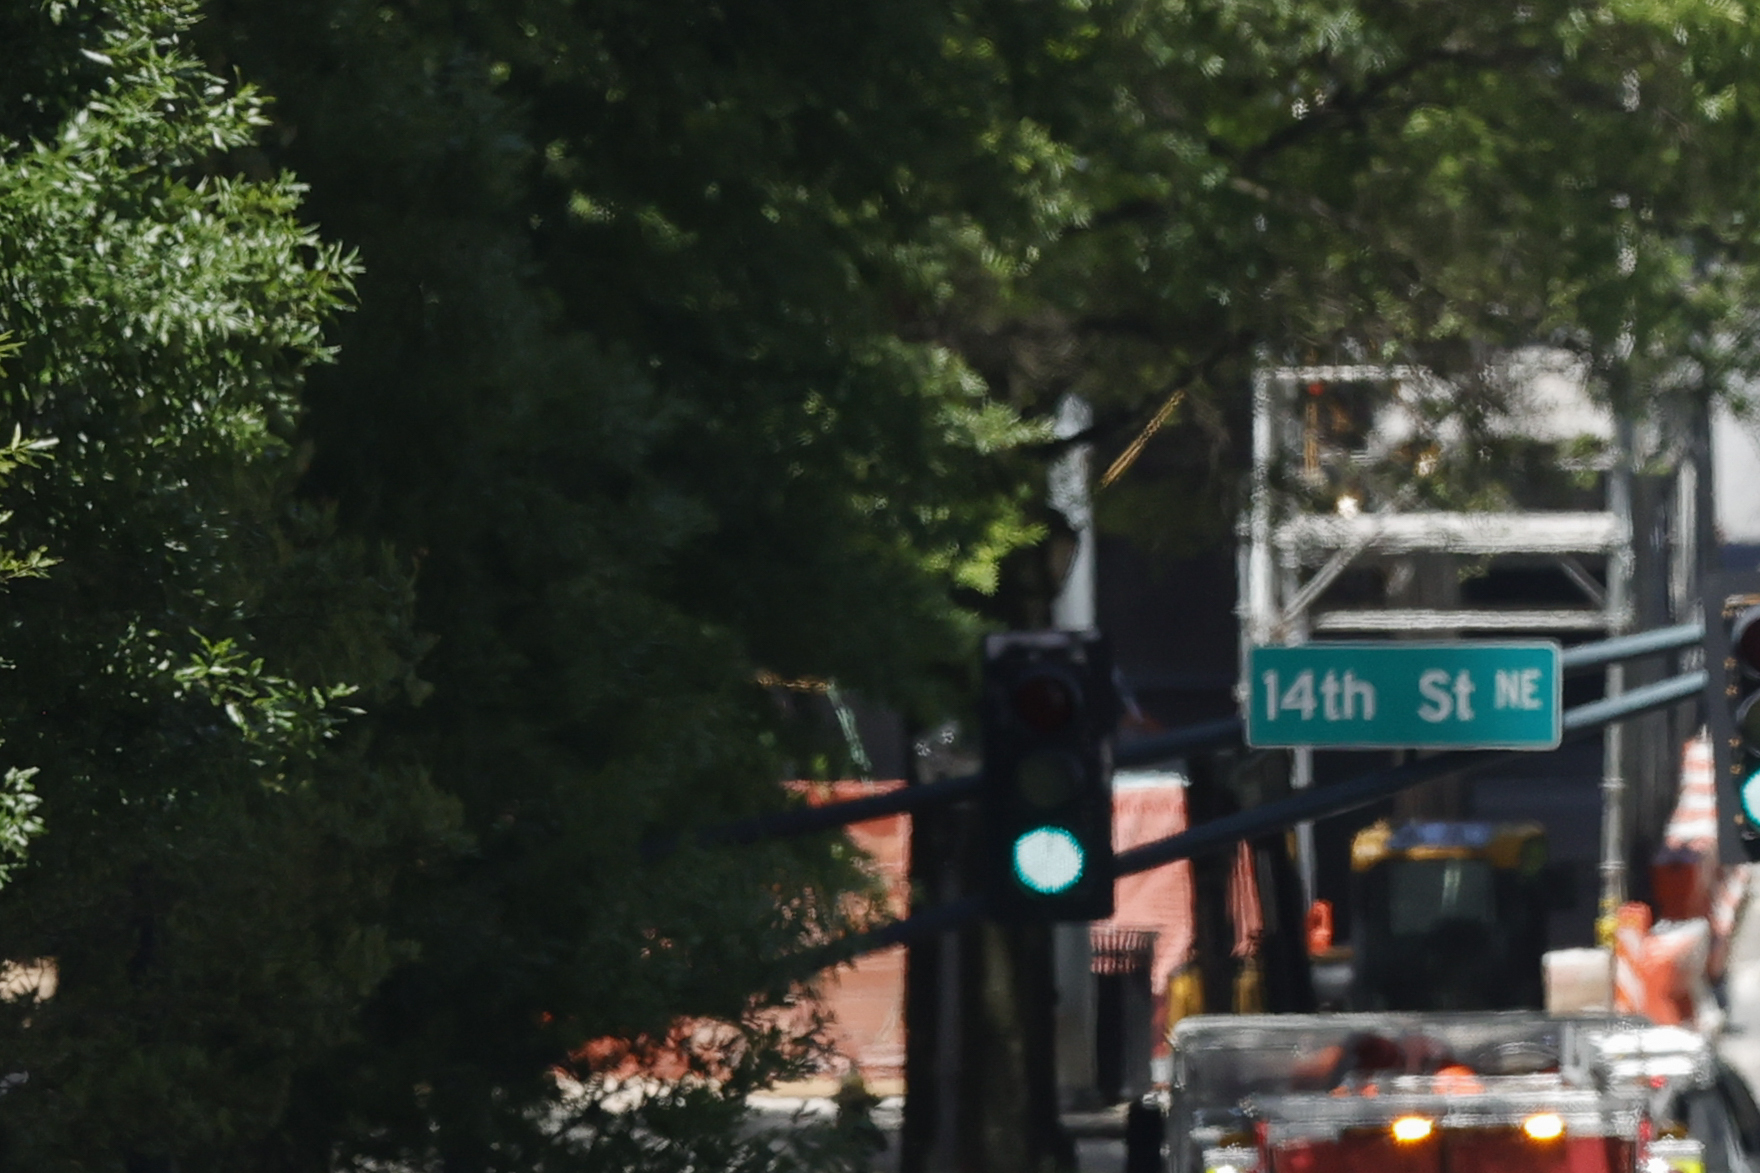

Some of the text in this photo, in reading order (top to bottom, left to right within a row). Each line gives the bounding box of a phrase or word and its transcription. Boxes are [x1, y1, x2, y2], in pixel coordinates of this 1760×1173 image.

[1261, 668, 1543, 723] 14th St NE
